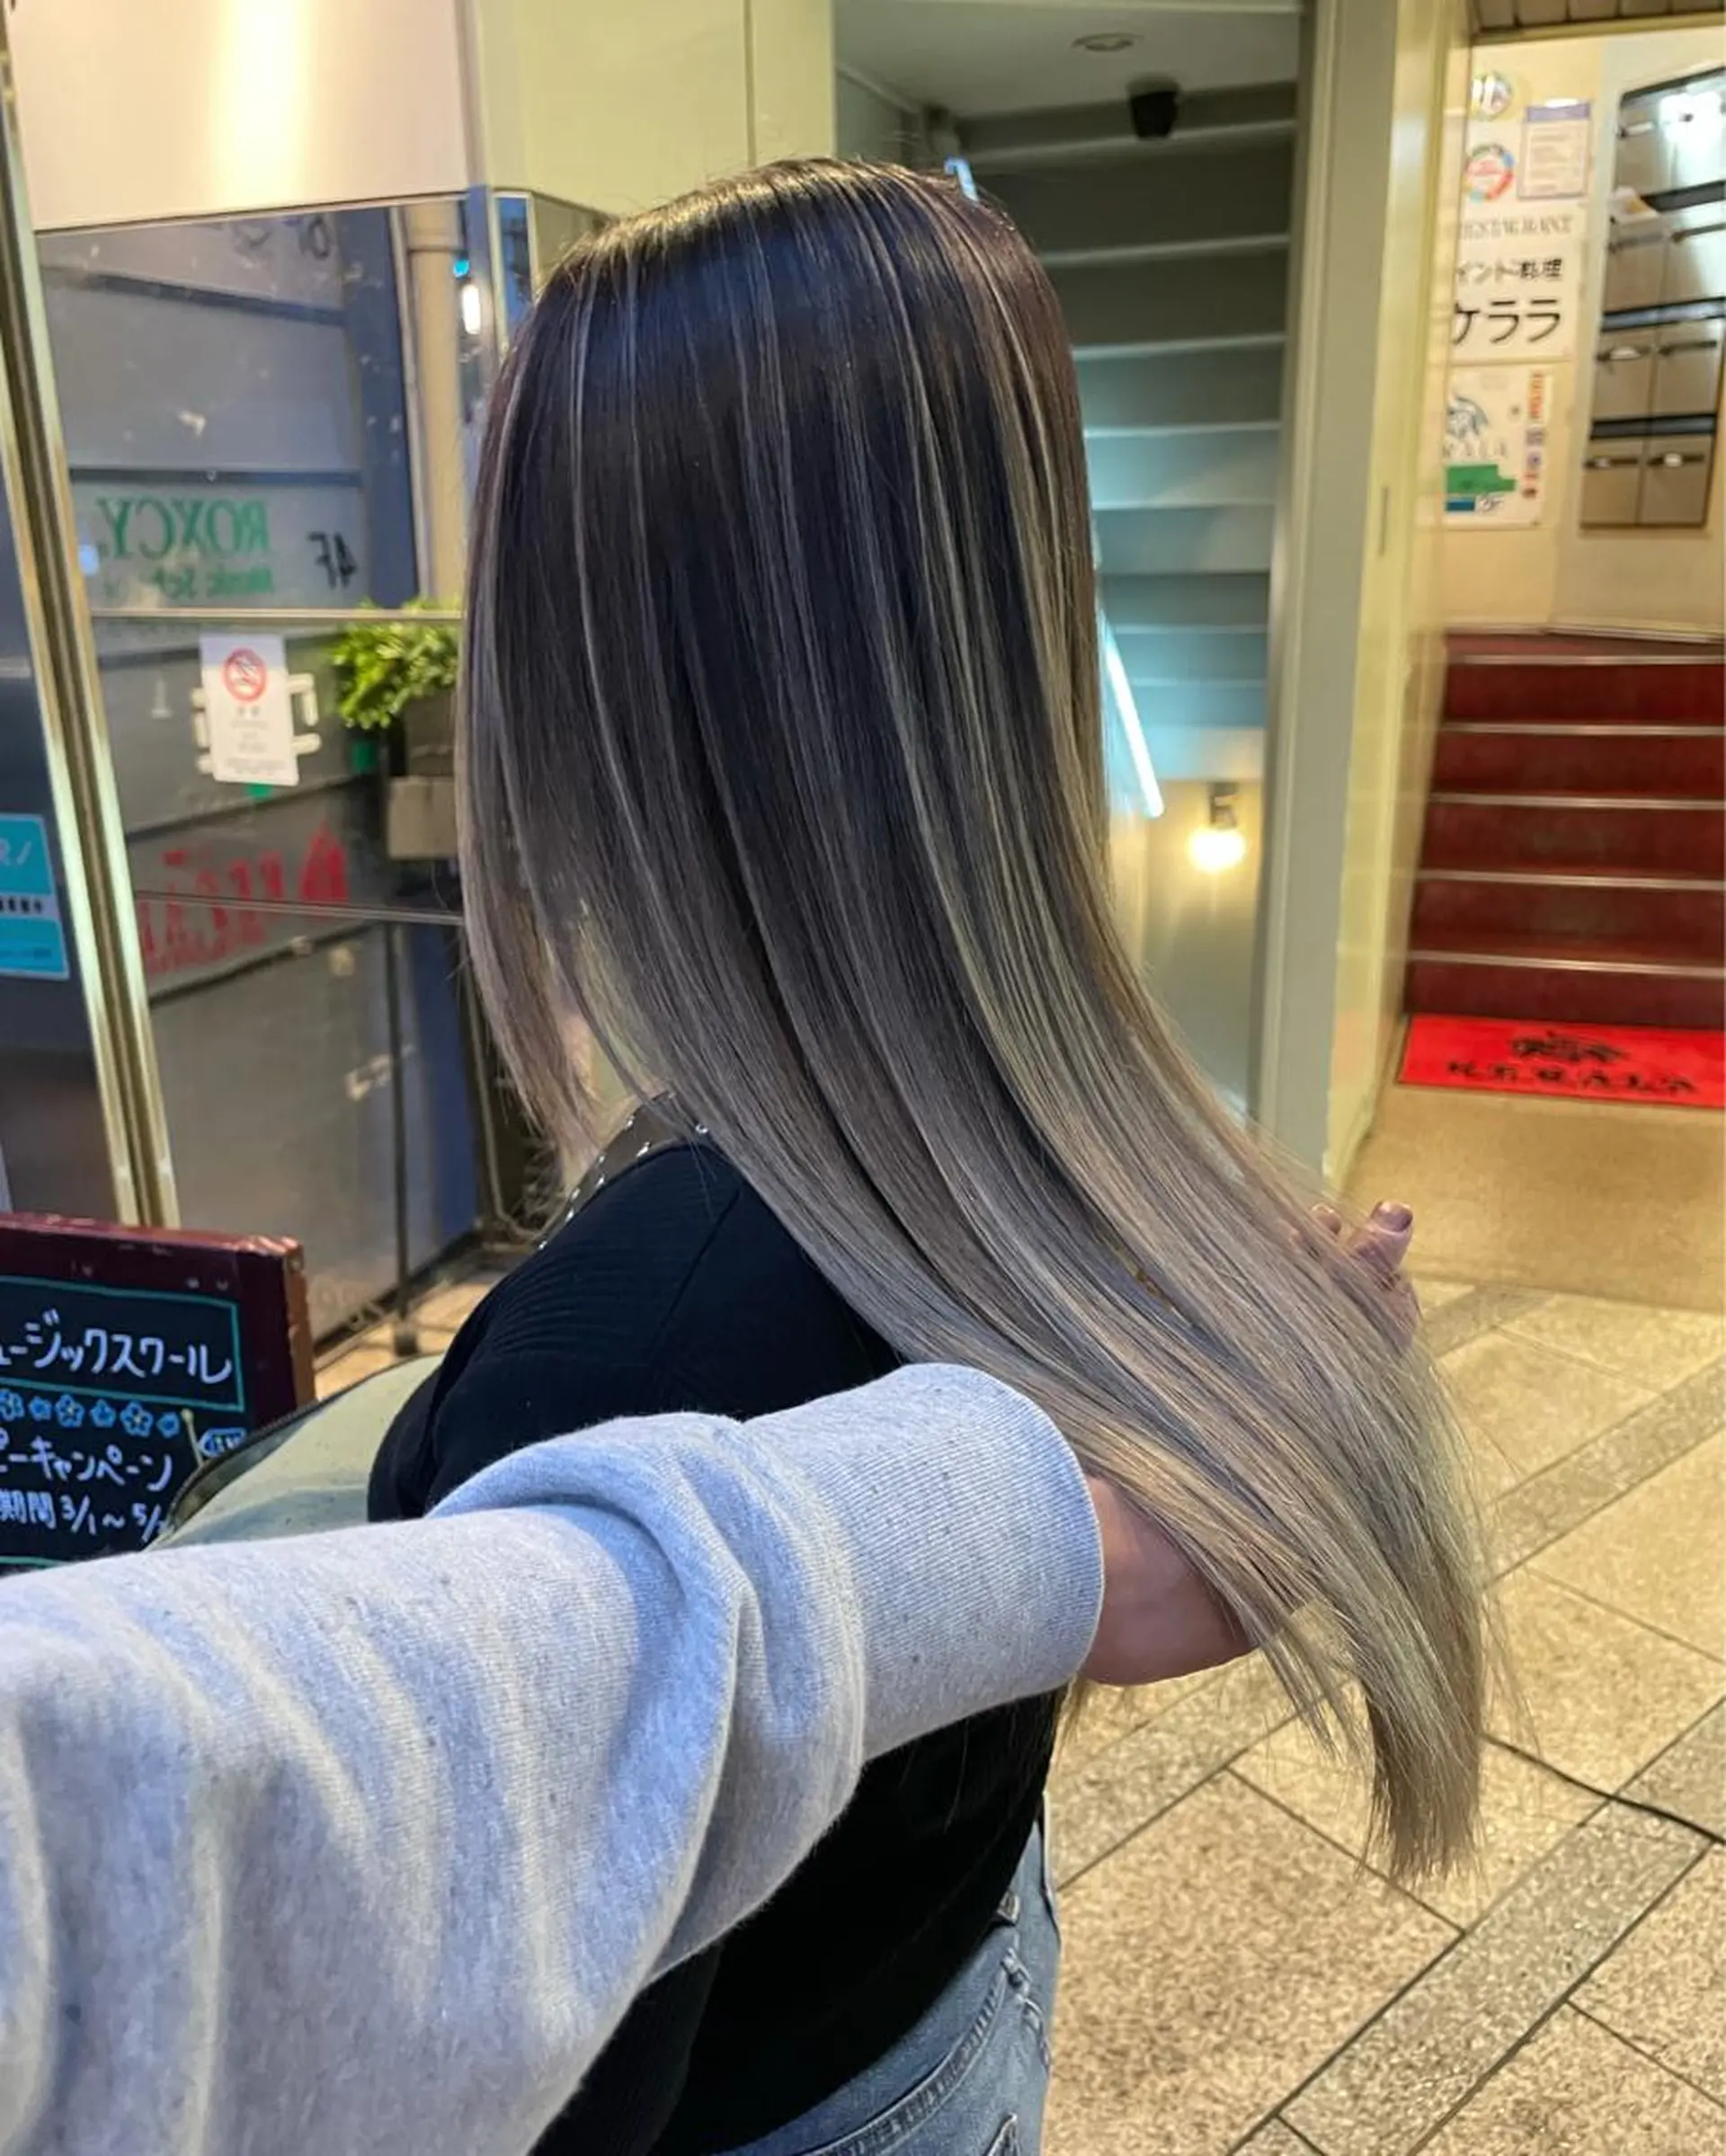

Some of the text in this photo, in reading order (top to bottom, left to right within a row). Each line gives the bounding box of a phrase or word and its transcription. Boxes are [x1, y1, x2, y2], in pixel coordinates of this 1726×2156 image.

[1461, 213, 1573, 241] ESTAURANT
[1452, 298, 1561, 345] ケララ
